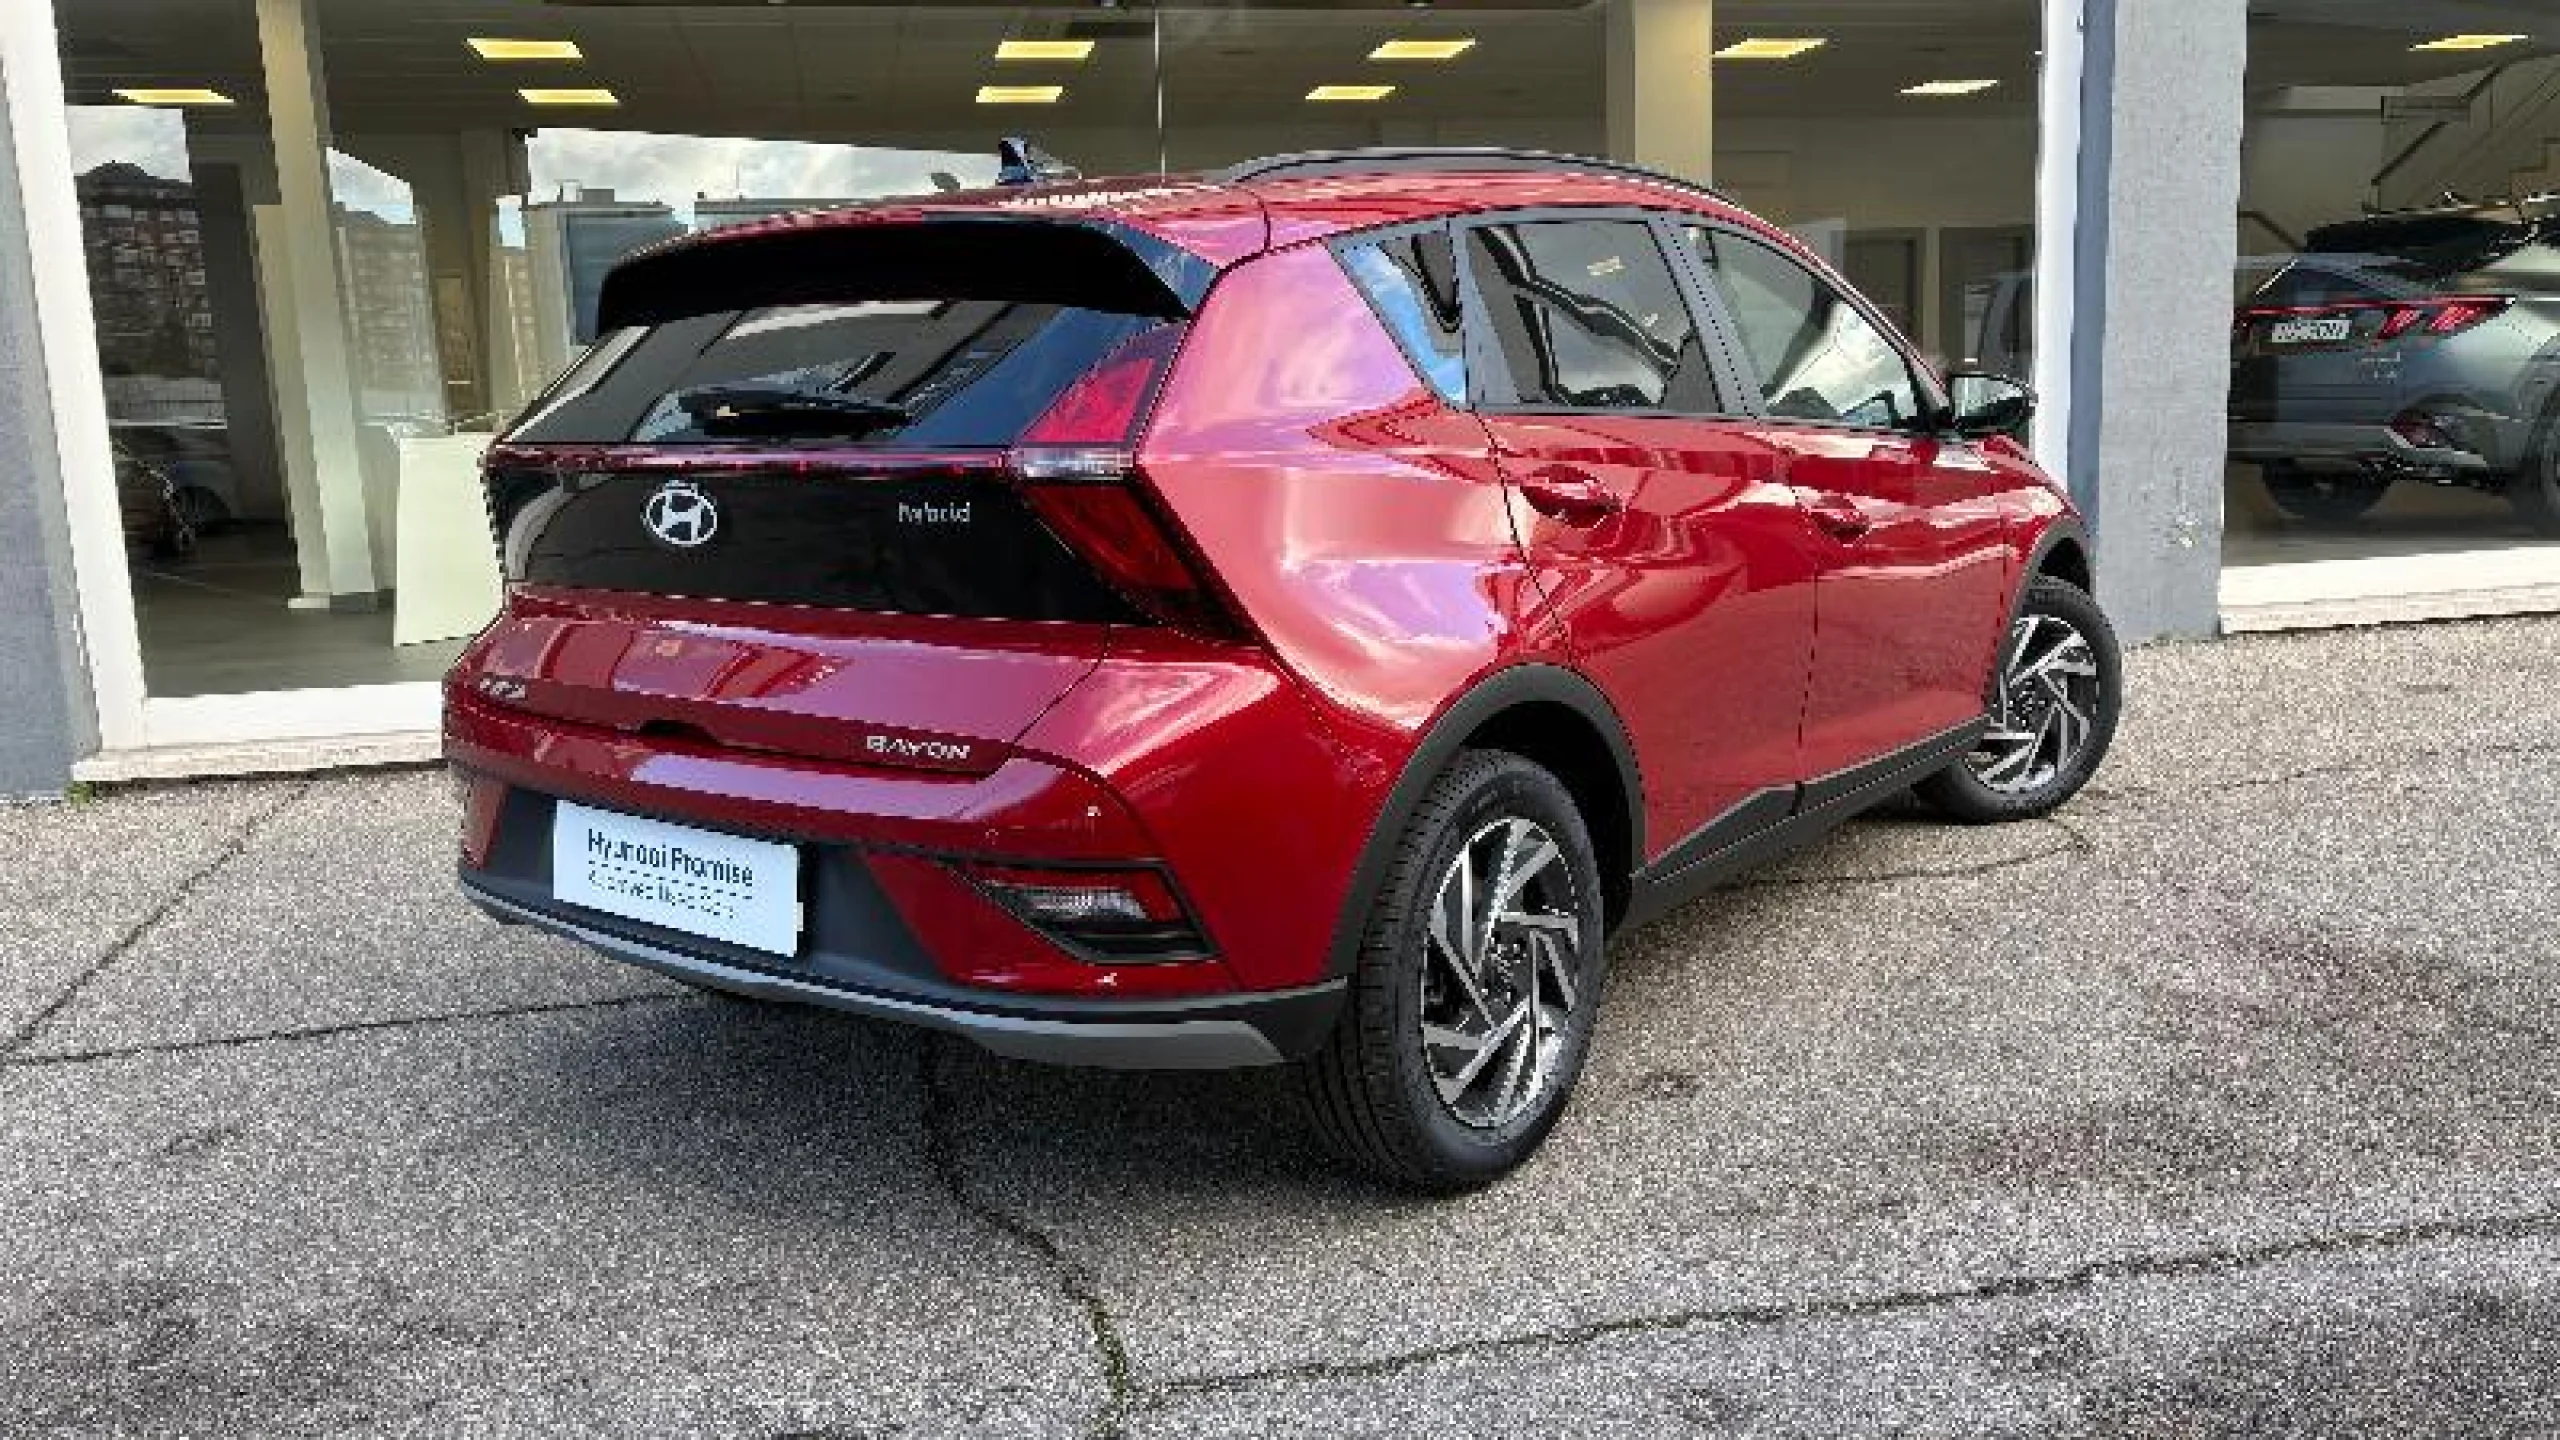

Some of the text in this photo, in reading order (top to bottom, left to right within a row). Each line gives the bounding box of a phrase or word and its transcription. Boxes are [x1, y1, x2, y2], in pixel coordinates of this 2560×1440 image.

[899, 502, 970, 525] hybrid
[867, 736, 970, 759] BAYON
[588, 828, 667, 868] Hyundai
[671, 847, 753, 887] Promise
